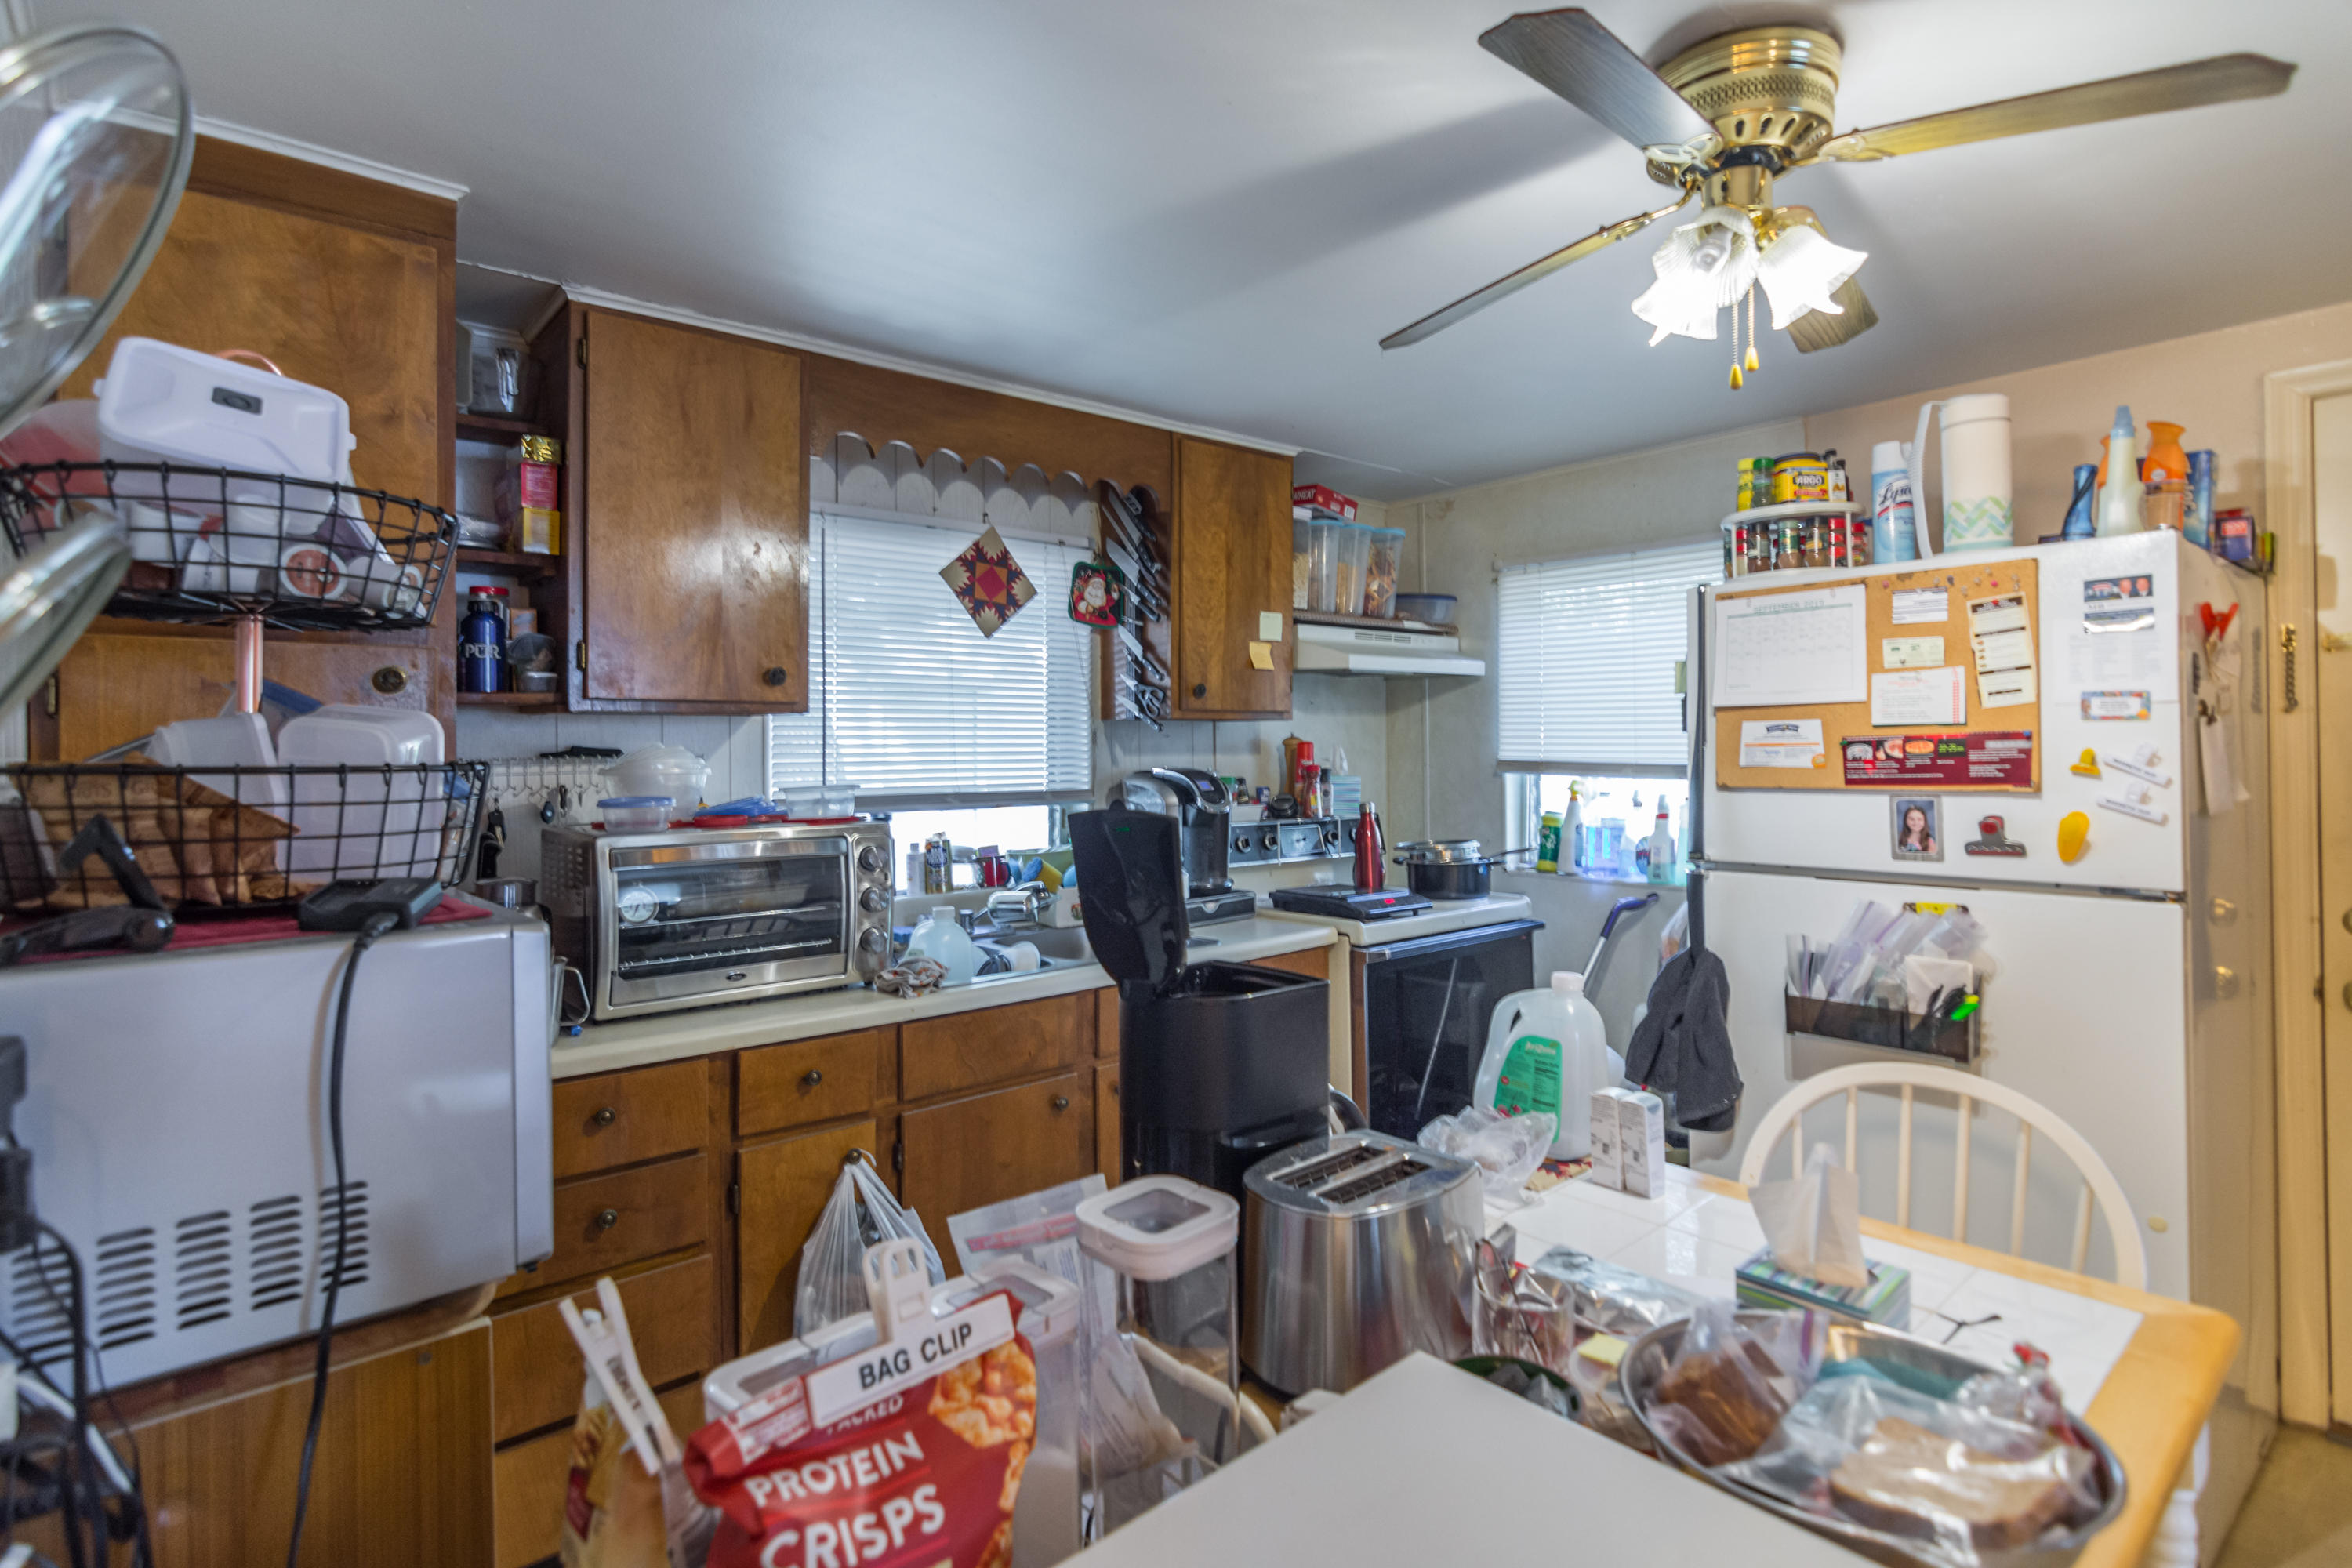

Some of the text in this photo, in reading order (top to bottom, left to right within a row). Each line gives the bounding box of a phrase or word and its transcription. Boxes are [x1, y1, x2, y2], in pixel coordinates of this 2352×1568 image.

[1796, 475, 1822, 485] ARGO
[859, 1323, 972, 1389] BAG CLIP
[746, 1432, 924, 1508] PROTEIN
[760, 1485, 946, 1568] CRISPS
